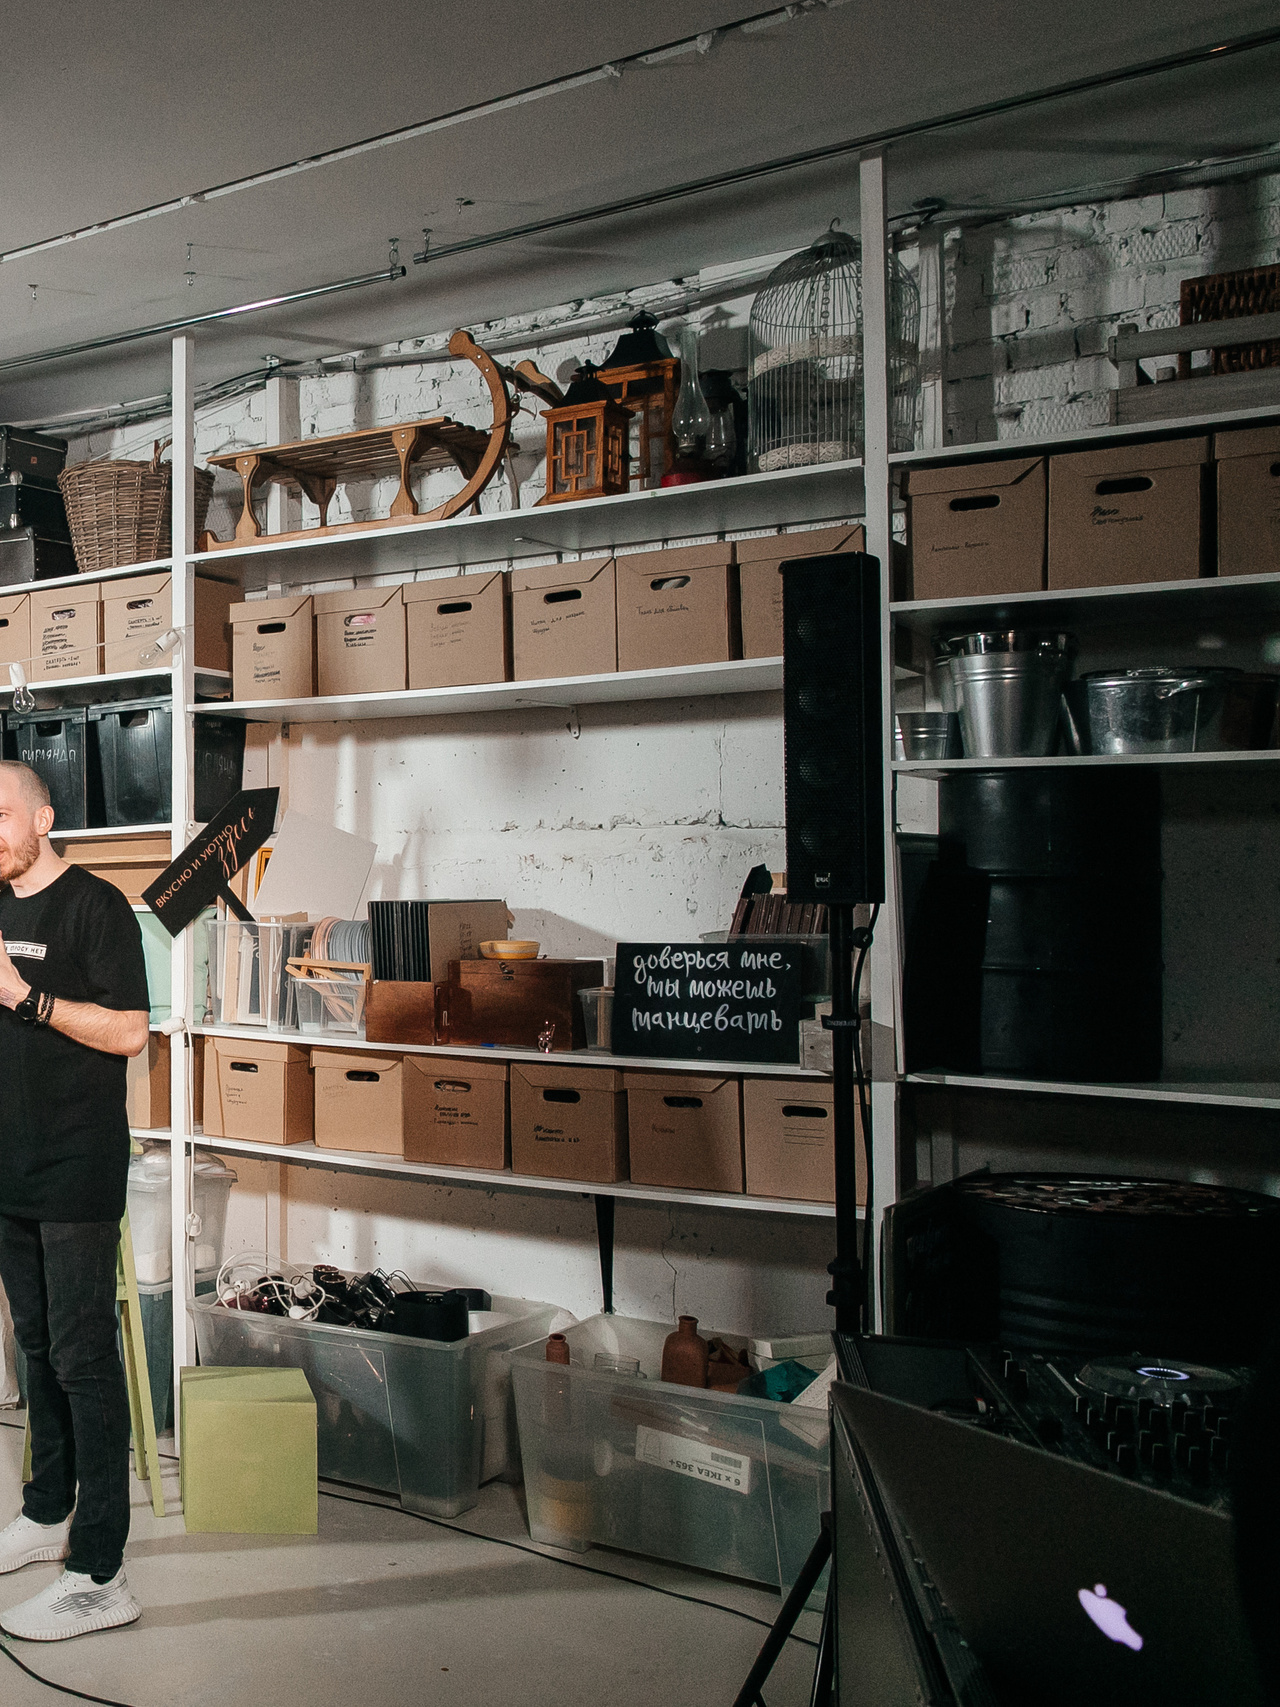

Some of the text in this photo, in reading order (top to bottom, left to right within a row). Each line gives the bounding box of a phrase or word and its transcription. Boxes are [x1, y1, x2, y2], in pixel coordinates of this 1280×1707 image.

[155, 824, 234, 909] ВКУСНО И УЮТНО
[632, 945, 792, 984] доверься мне,
[646, 974, 777, 999] ты можешь
[631, 1003, 783, 1034] танцевать
[668, 1458, 694, 1472] 365+
[696, 1466, 722, 1481] IKEA
[733, 1478, 741, 1487] 6
